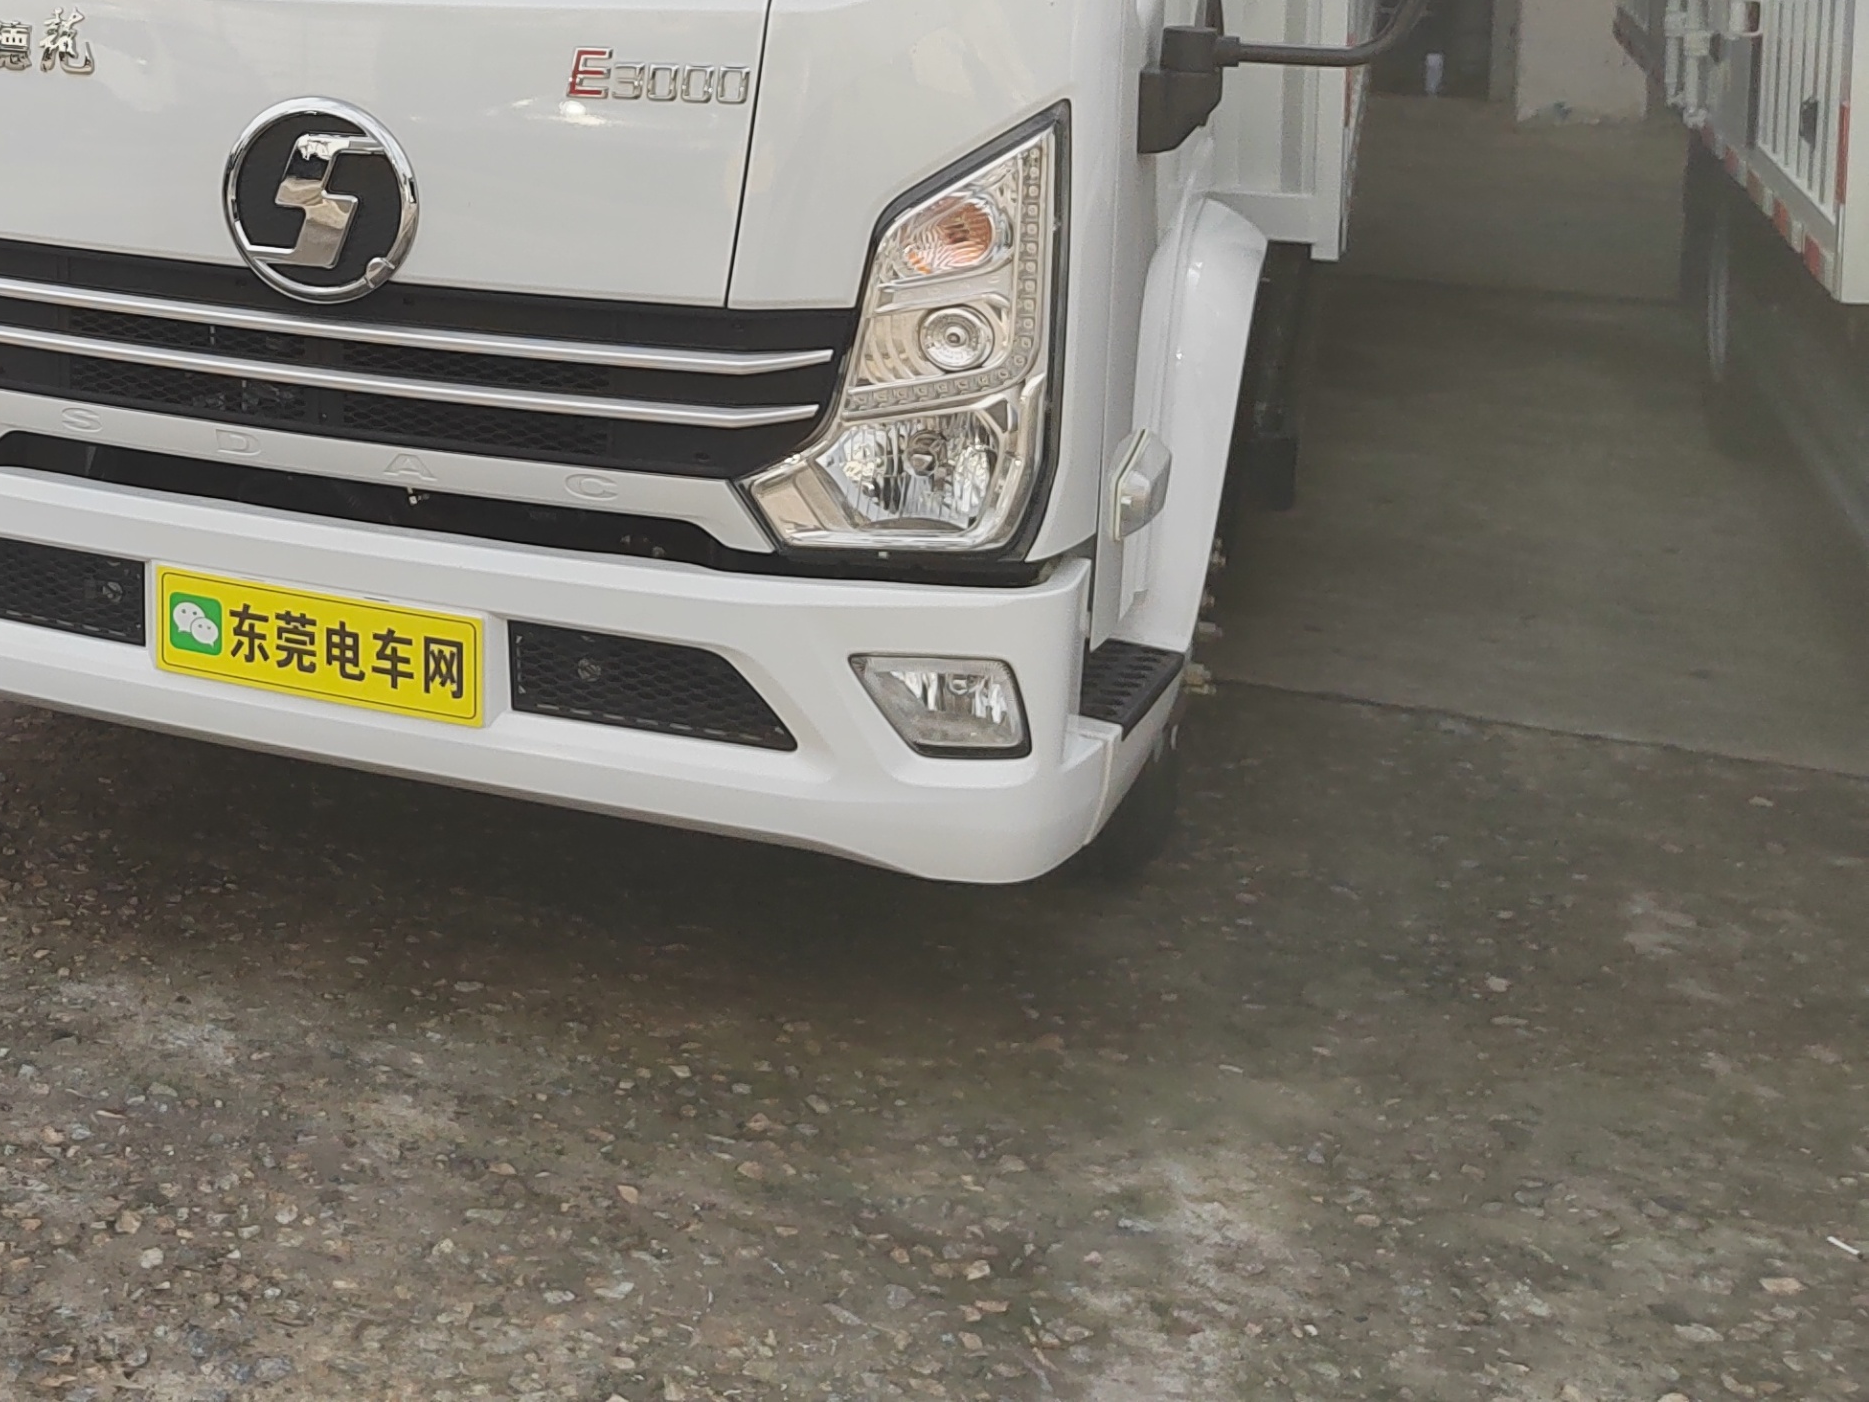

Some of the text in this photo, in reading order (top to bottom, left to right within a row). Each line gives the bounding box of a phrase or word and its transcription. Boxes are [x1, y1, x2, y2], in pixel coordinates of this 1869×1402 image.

[566, 46, 751, 104] E3000
[60, 406, 619, 501] SDAC
[228, 603, 465, 700] 东莞电车网
